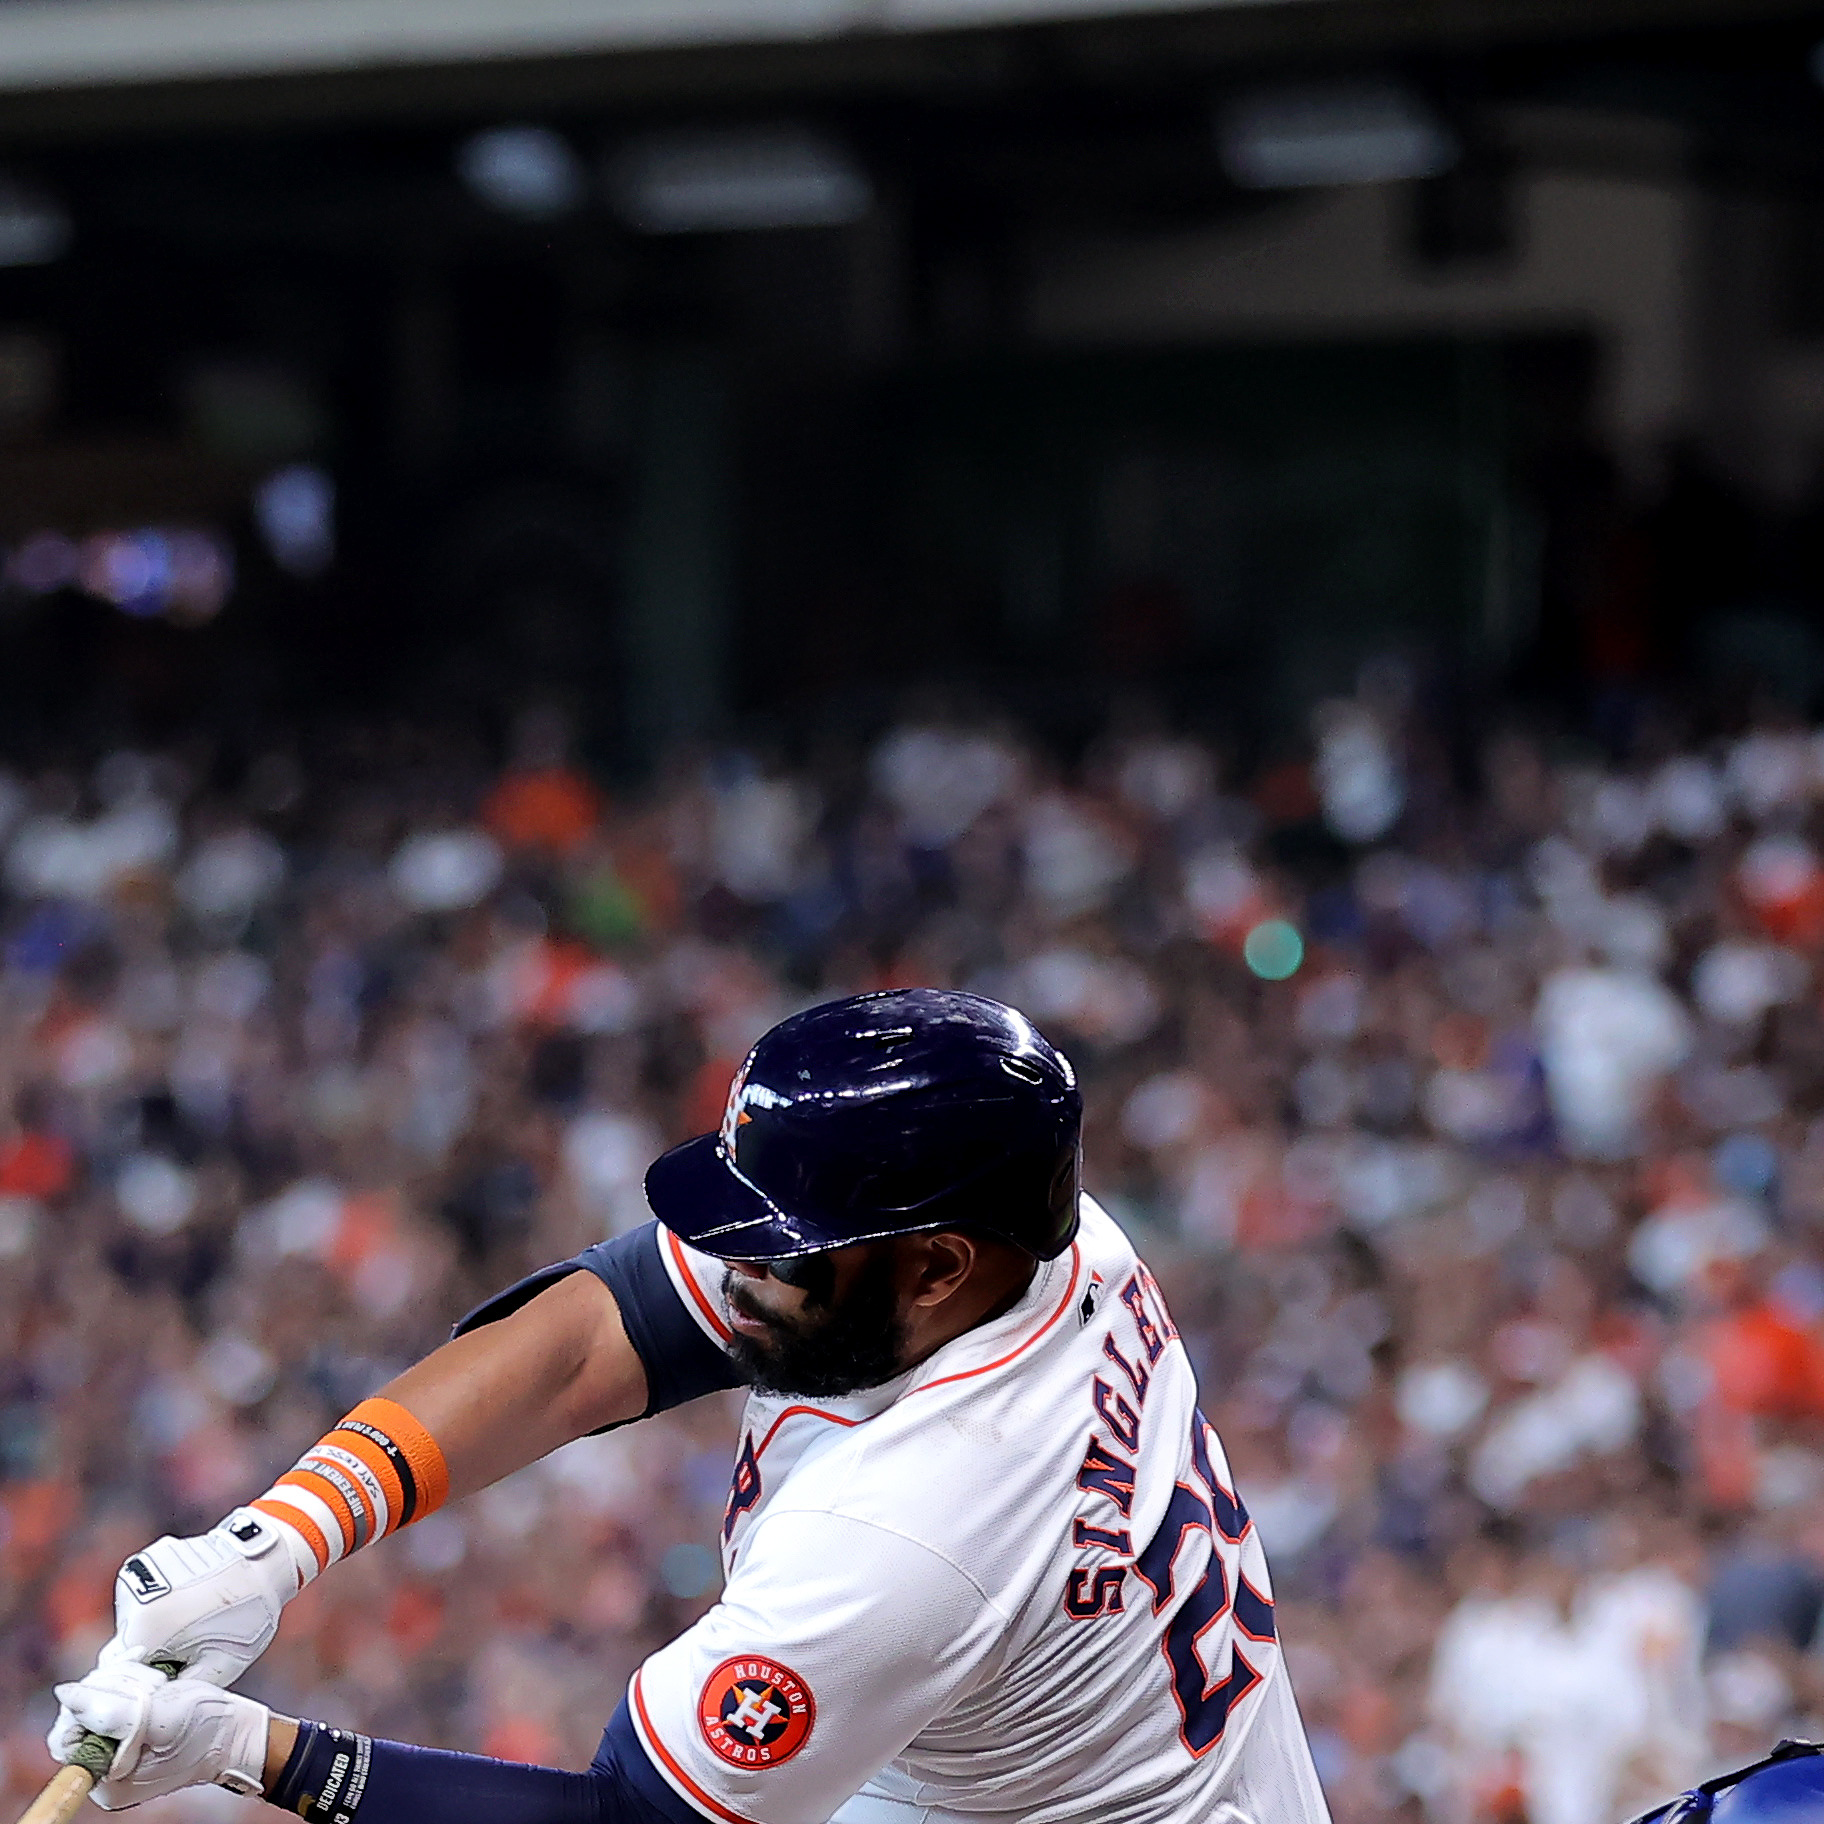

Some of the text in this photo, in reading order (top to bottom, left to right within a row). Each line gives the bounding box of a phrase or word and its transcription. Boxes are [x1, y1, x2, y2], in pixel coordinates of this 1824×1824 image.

[315, 1462, 365, 1518] DIFFERENT
[360, 1469, 379, 1499] SAY
[726, 1687, 782, 1740] H
[733, 1662, 808, 1714] HOUSTON
[704, 1715, 771, 1761] ASTROS
[316, 1752, 350, 1812] DEDICATED
